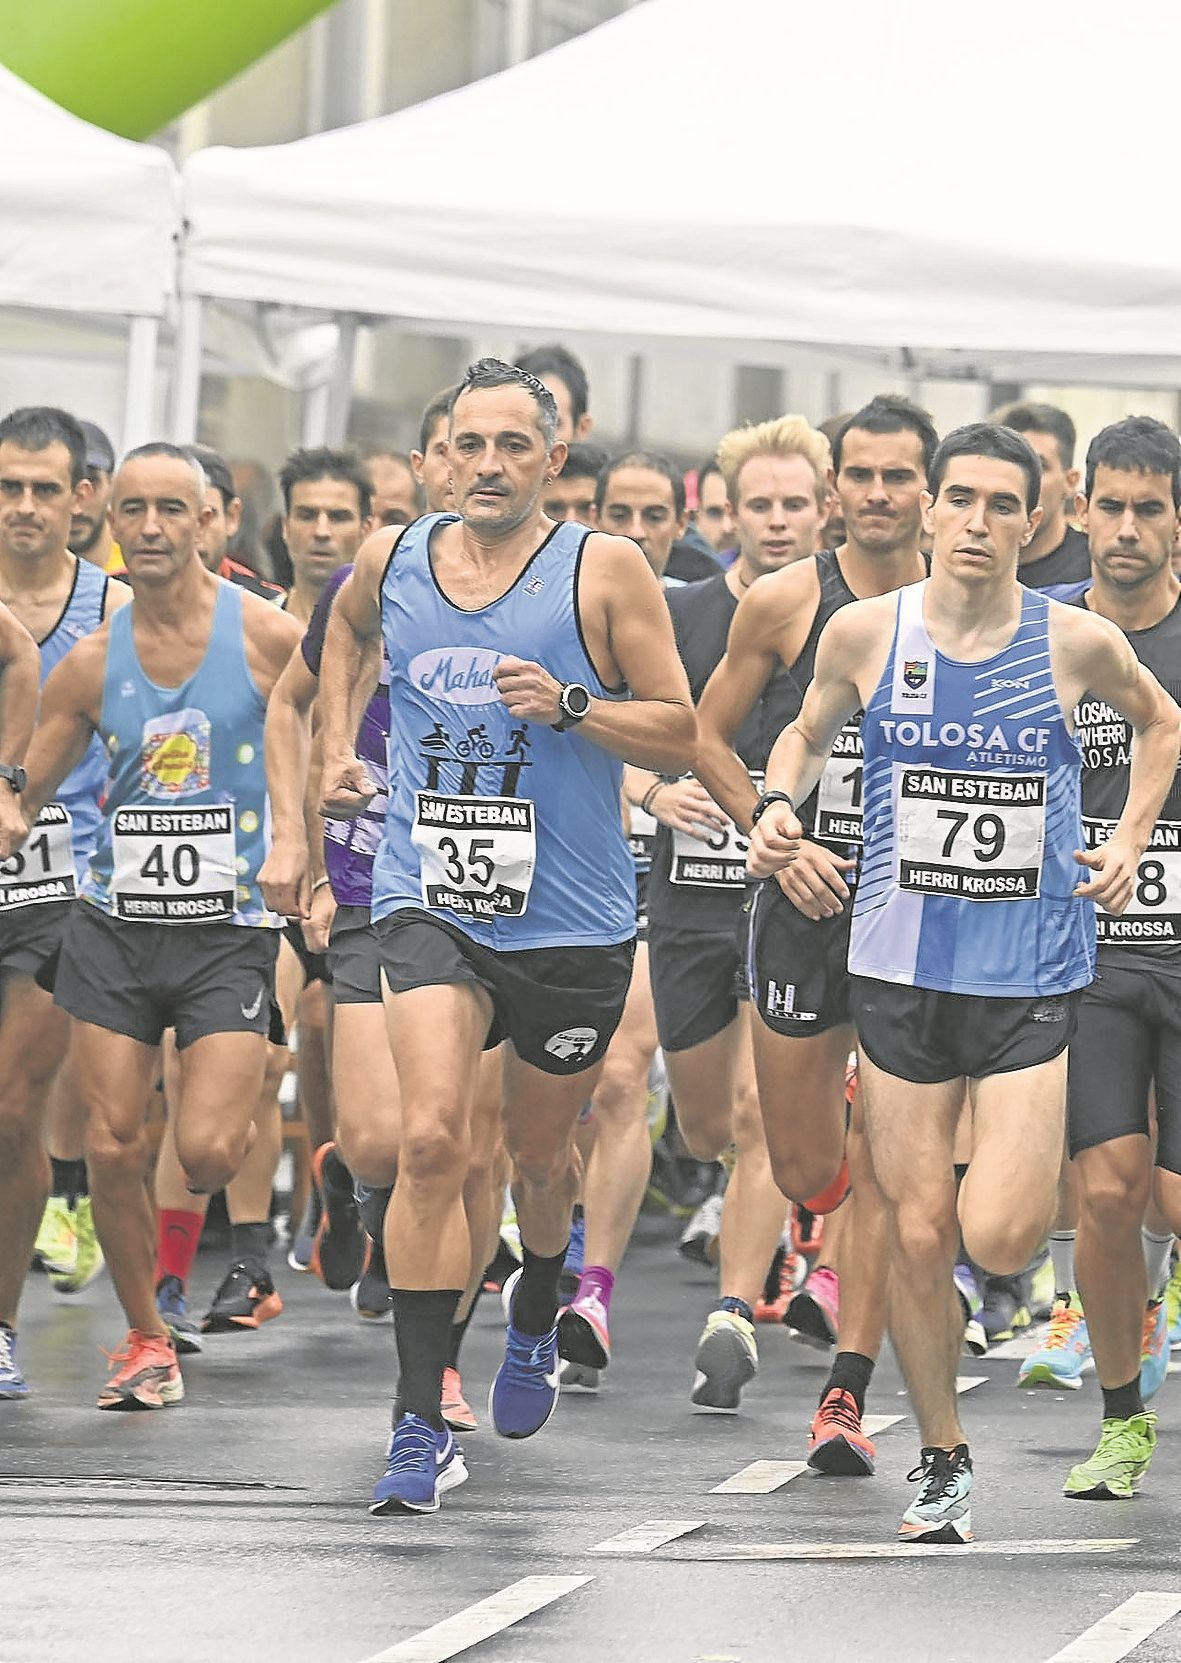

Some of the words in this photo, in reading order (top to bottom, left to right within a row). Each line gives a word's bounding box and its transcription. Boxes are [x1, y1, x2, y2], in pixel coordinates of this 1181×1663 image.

[879, 720, 1010, 751] TOLOSA
[1018, 727, 1051, 753] CF
[966, 751, 1048, 769] ATLETISMO
[907, 775, 947, 795] SAN
[951, 778, 1039, 801] ESTEBAN
[117, 813, 148, 832] SAN
[151, 812, 228, 832] ESTEBAN
[445, 804, 528, 826] ESTEBAN
[937, 809, 1006, 862] 79
[140, 843, 200, 887] 40
[438, 836, 496, 888] 35
[683, 863, 724, 881] HERRI
[7, 880, 68, 903] KROSSA
[909, 869, 959, 890] HERRI
[962, 875, 1028, 893] KROSSA
[123, 899, 165, 915] HERRI
[166, 898, 226, 916] KROSSA
[1109, 921, 1175, 937] KROSSA
